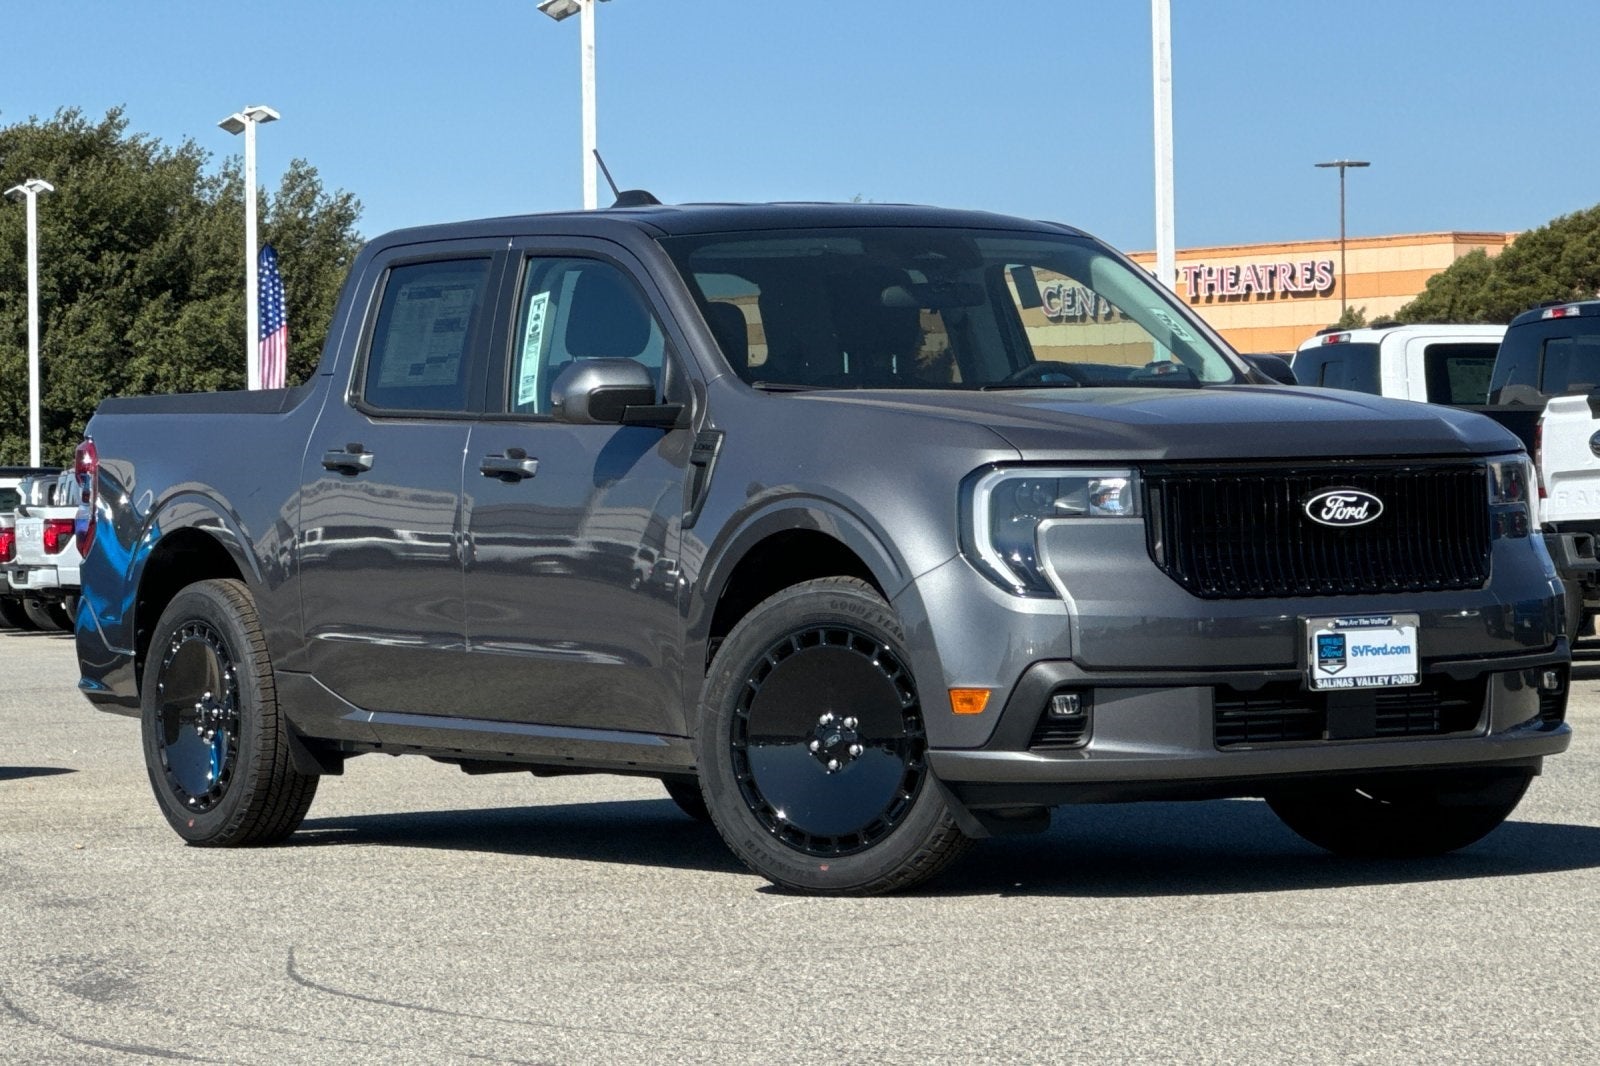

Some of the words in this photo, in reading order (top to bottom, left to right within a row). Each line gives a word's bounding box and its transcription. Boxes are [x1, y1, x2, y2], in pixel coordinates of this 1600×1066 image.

[1183, 260, 1334, 297] THEATRES
[1321, 495, 1369, 520] Ford
[1351, 644, 1411, 657] SVFord.com
[1316, 677, 1354, 689] SALINAS
[1356, 675, 1389, 687] VALLEY
[1391, 674, 1415, 685] FORD
